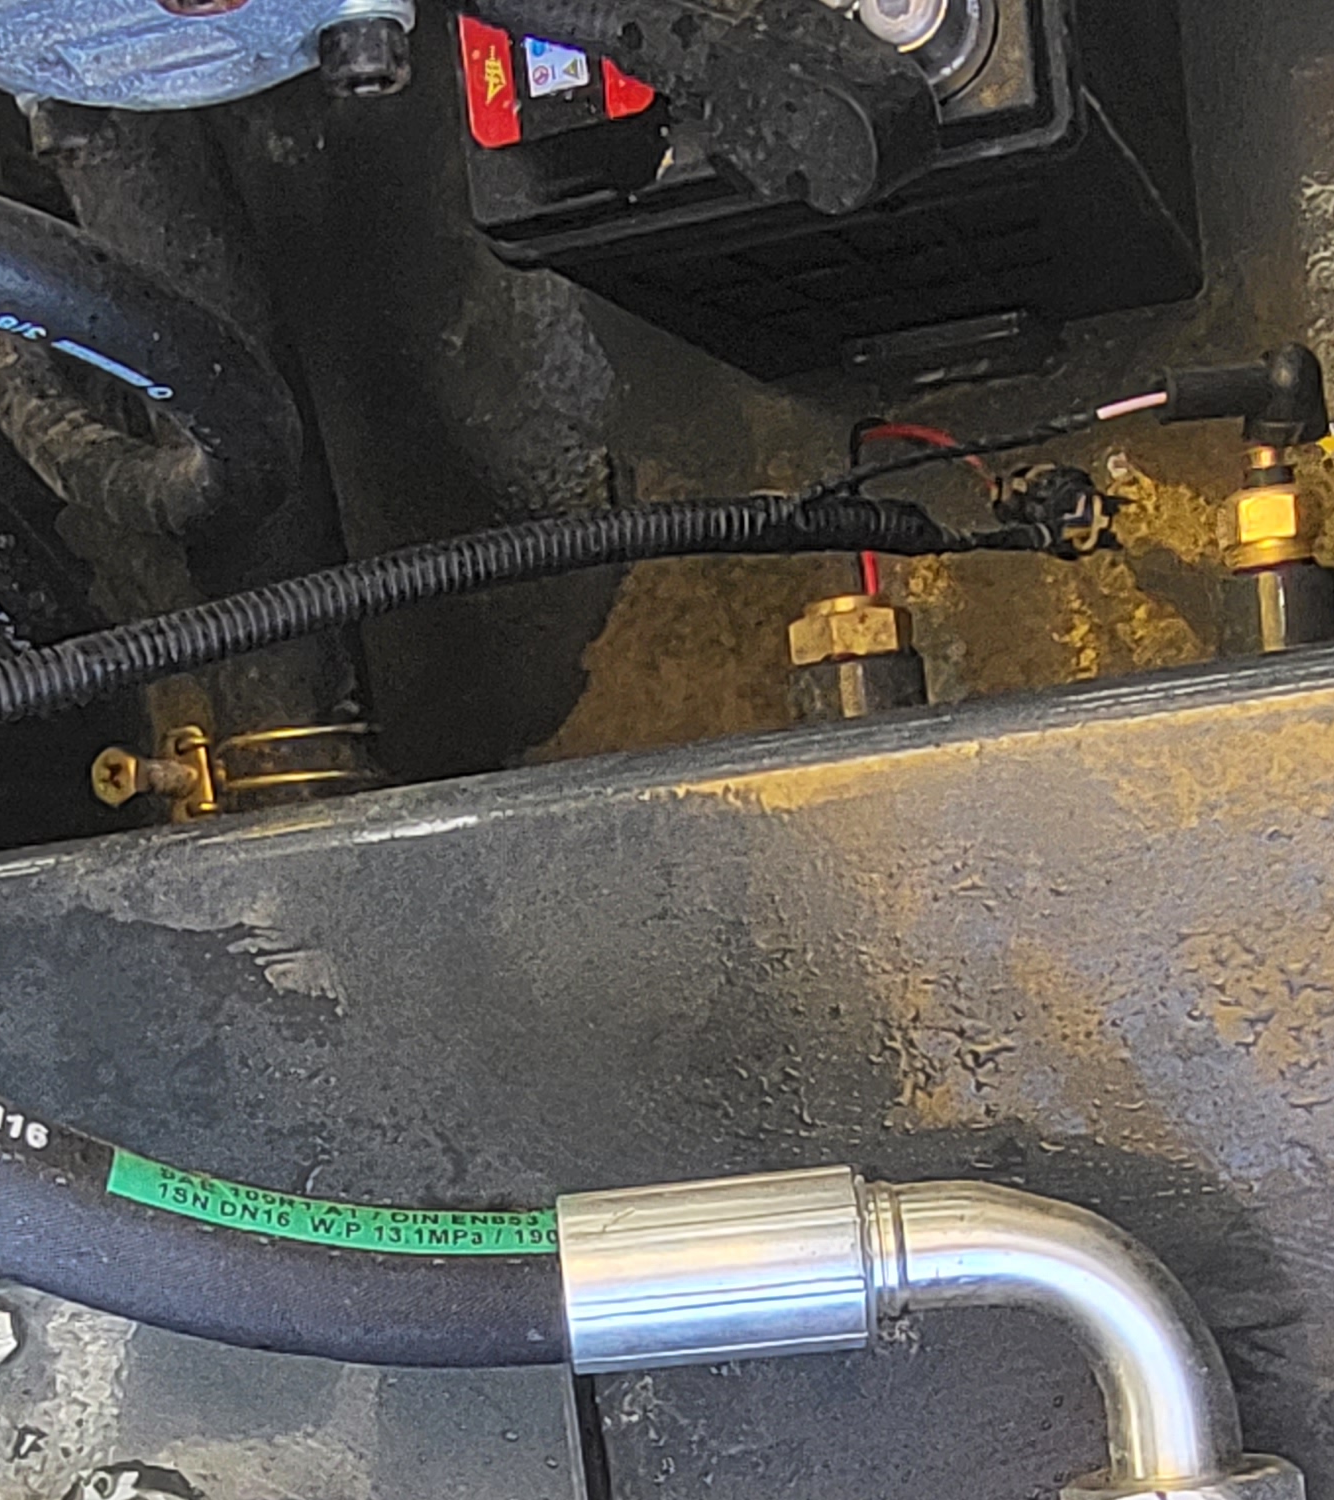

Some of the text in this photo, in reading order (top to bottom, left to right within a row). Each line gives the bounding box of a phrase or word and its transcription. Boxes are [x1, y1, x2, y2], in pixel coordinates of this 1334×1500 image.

[157, 1181, 209, 1213] 1SN
[218, 1199, 292, 1229] DN16
[311, 1216, 364, 1240] W.P
[373, 1226, 485, 1248] 13.1MPa
[491, 1228, 503, 1245] /
[389, 1211, 441, 1225] DIN
